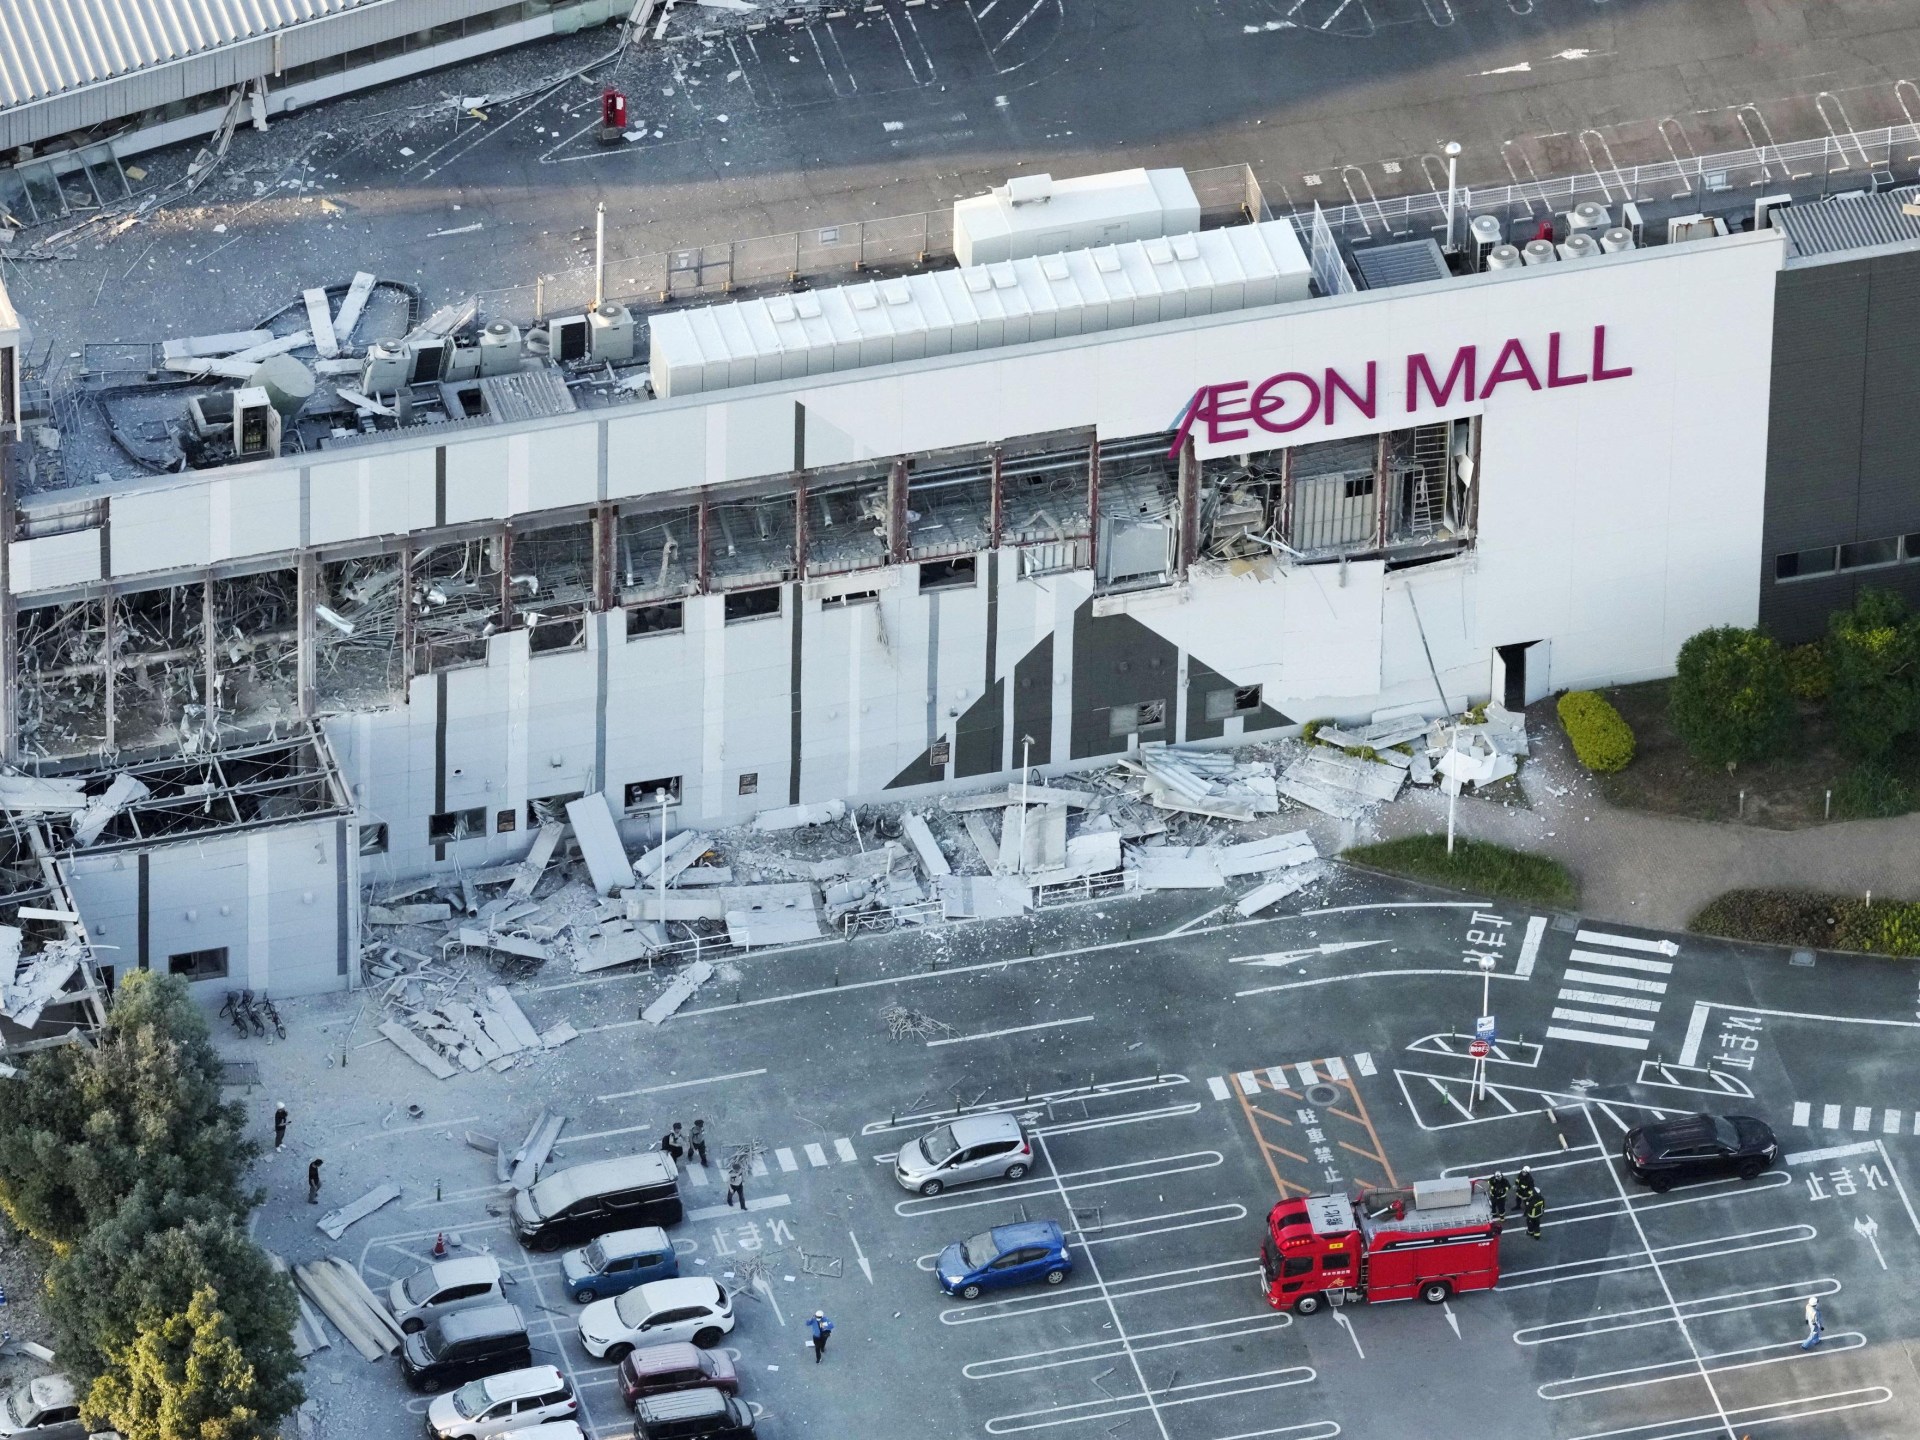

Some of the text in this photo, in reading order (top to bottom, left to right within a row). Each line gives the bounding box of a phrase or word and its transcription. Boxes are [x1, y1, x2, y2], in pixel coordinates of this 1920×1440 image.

[1406, 325, 1633, 412] MALL
[1713, 1016, 1763, 1070] 止まれ
[1296, 1108, 1344, 1183] 駐車禁止
[1806, 1163, 1889, 1201] 止まれ
[711, 1218, 795, 1256] 止まれ
